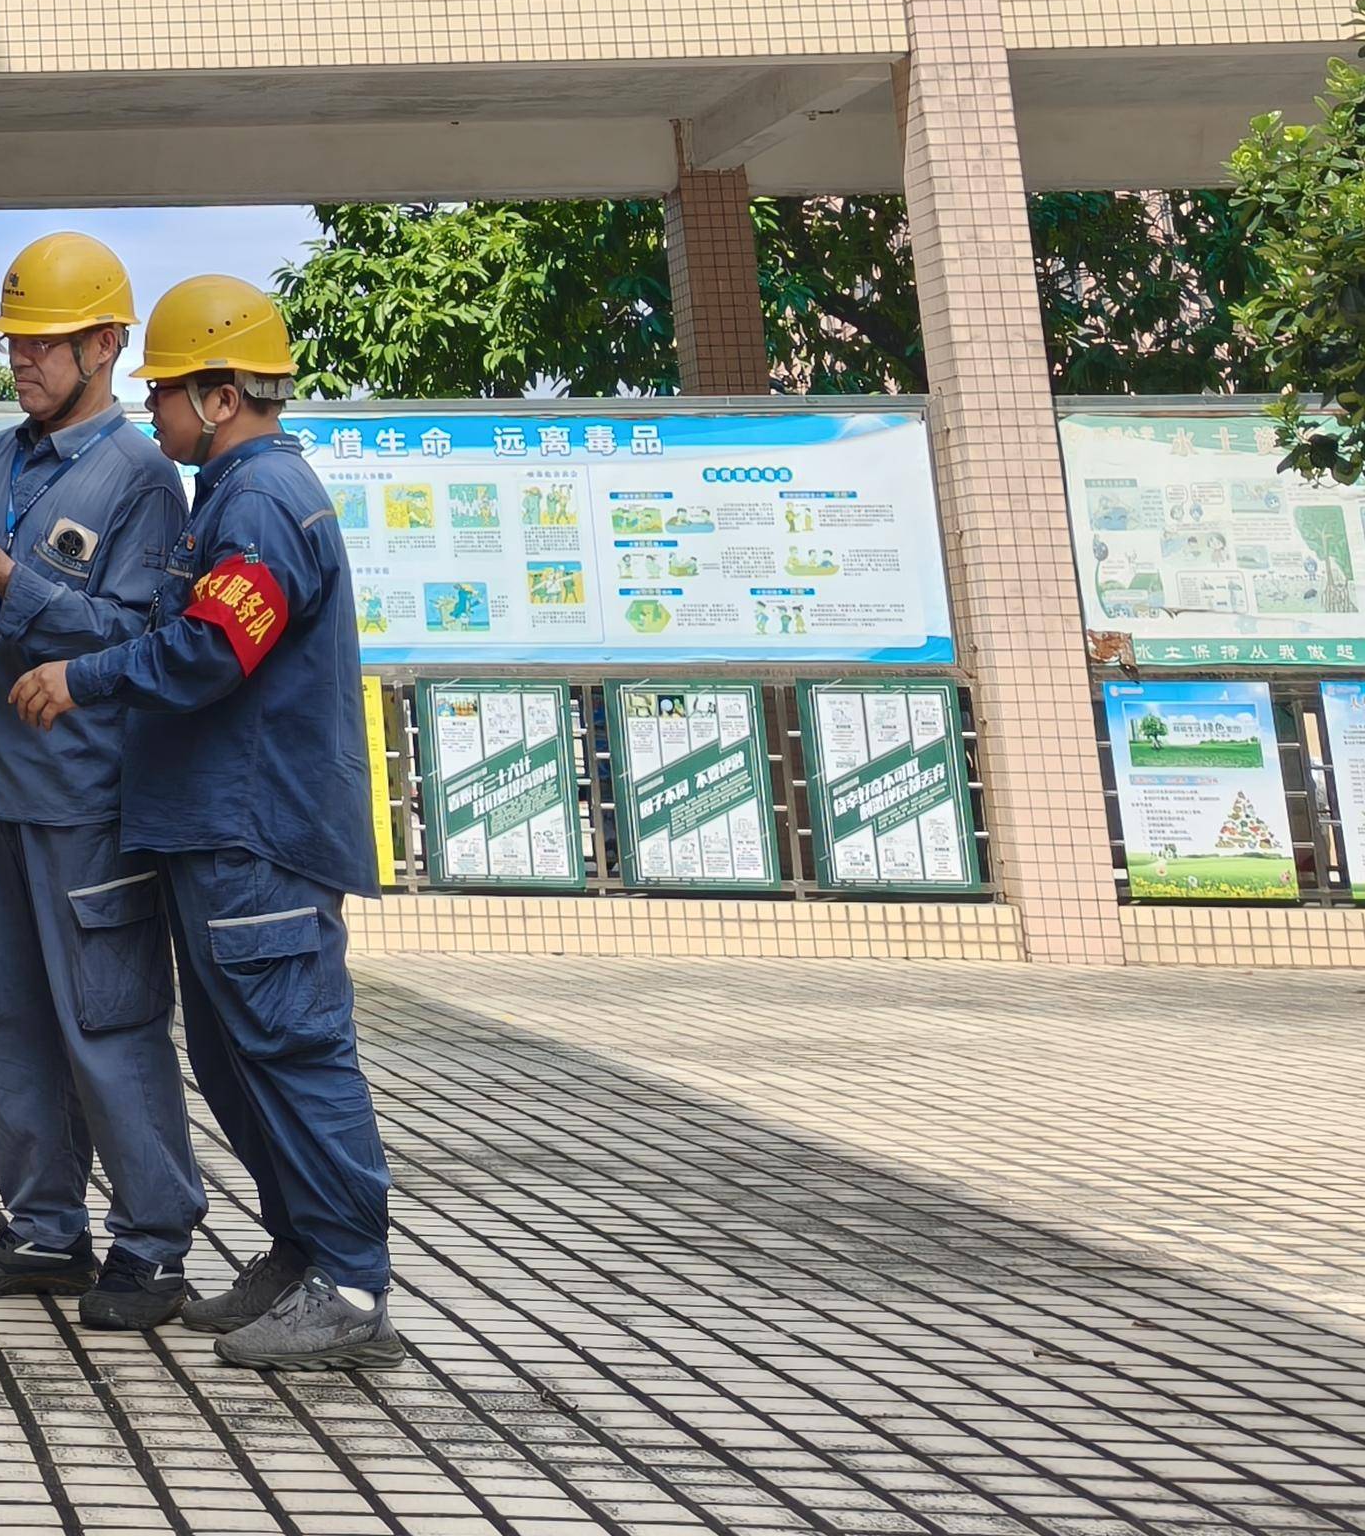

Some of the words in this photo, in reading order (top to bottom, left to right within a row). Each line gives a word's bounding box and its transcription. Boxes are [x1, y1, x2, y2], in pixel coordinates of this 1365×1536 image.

[492, 424, 665, 457] 远离毒品
[1135, 642, 1356, 661] 水土保持从我做起
